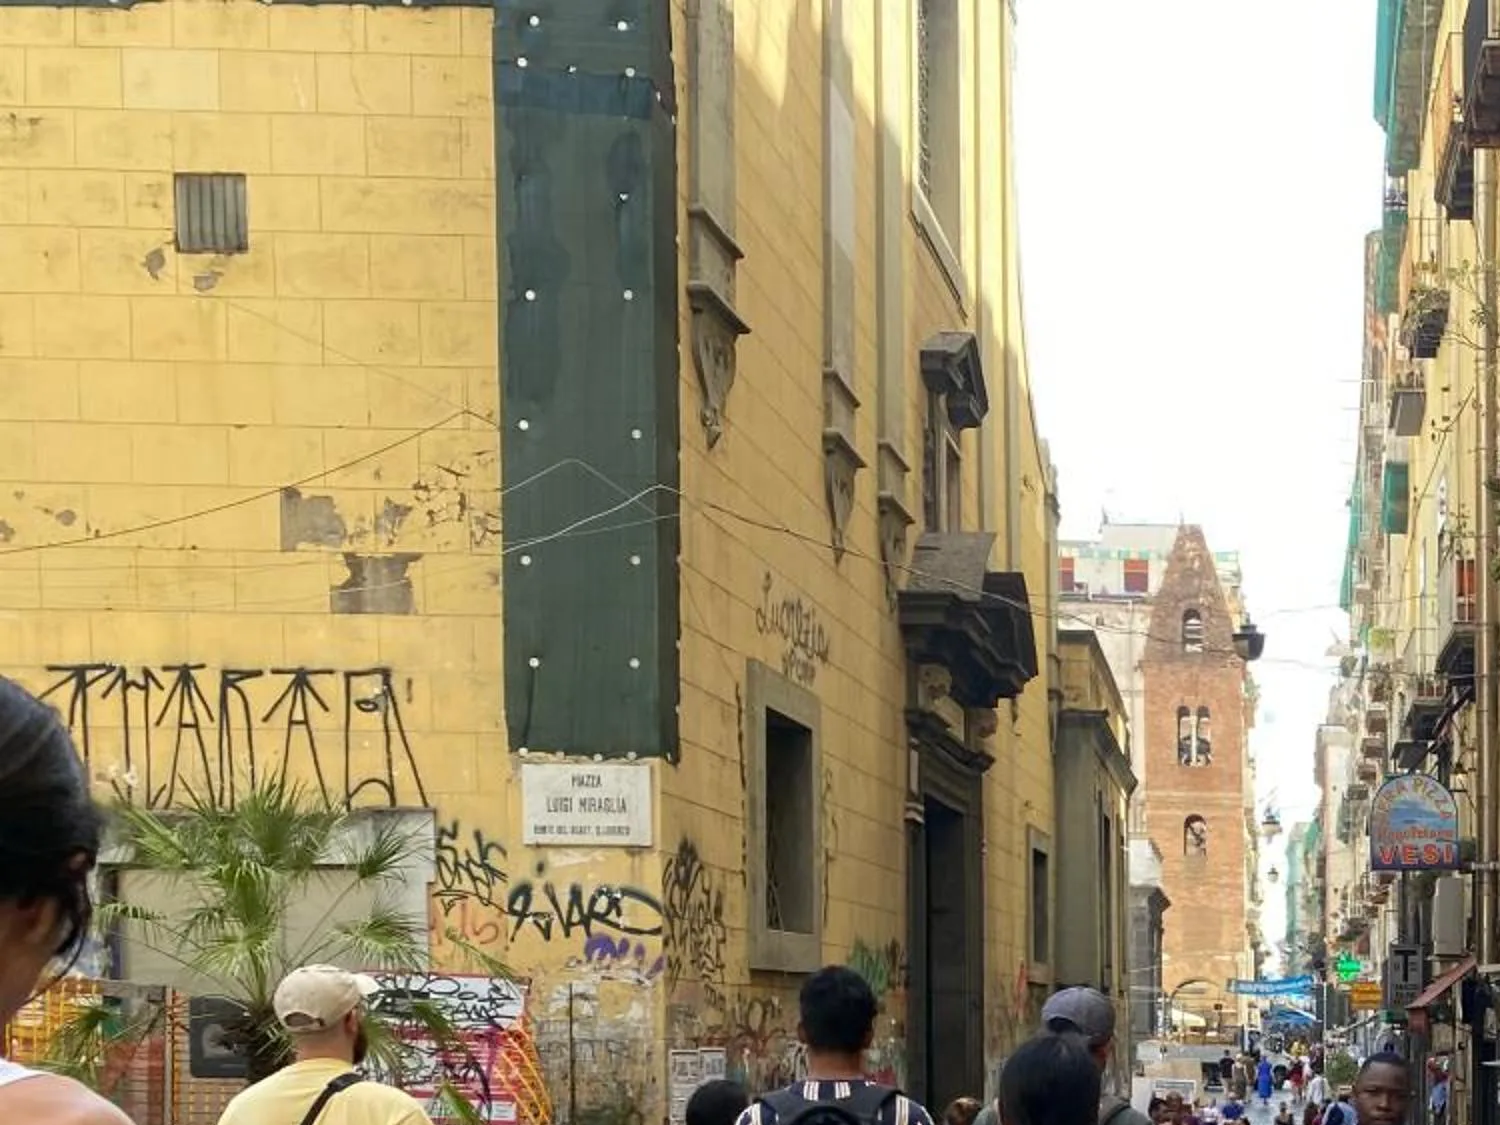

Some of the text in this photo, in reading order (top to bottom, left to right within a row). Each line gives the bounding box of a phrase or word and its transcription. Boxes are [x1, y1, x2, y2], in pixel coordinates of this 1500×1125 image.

[571, 773, 602, 788] PIAZZA
[546, 796, 627, 814] LUIGI MIRAGLIA
[1378, 842, 1454, 865] VESI
